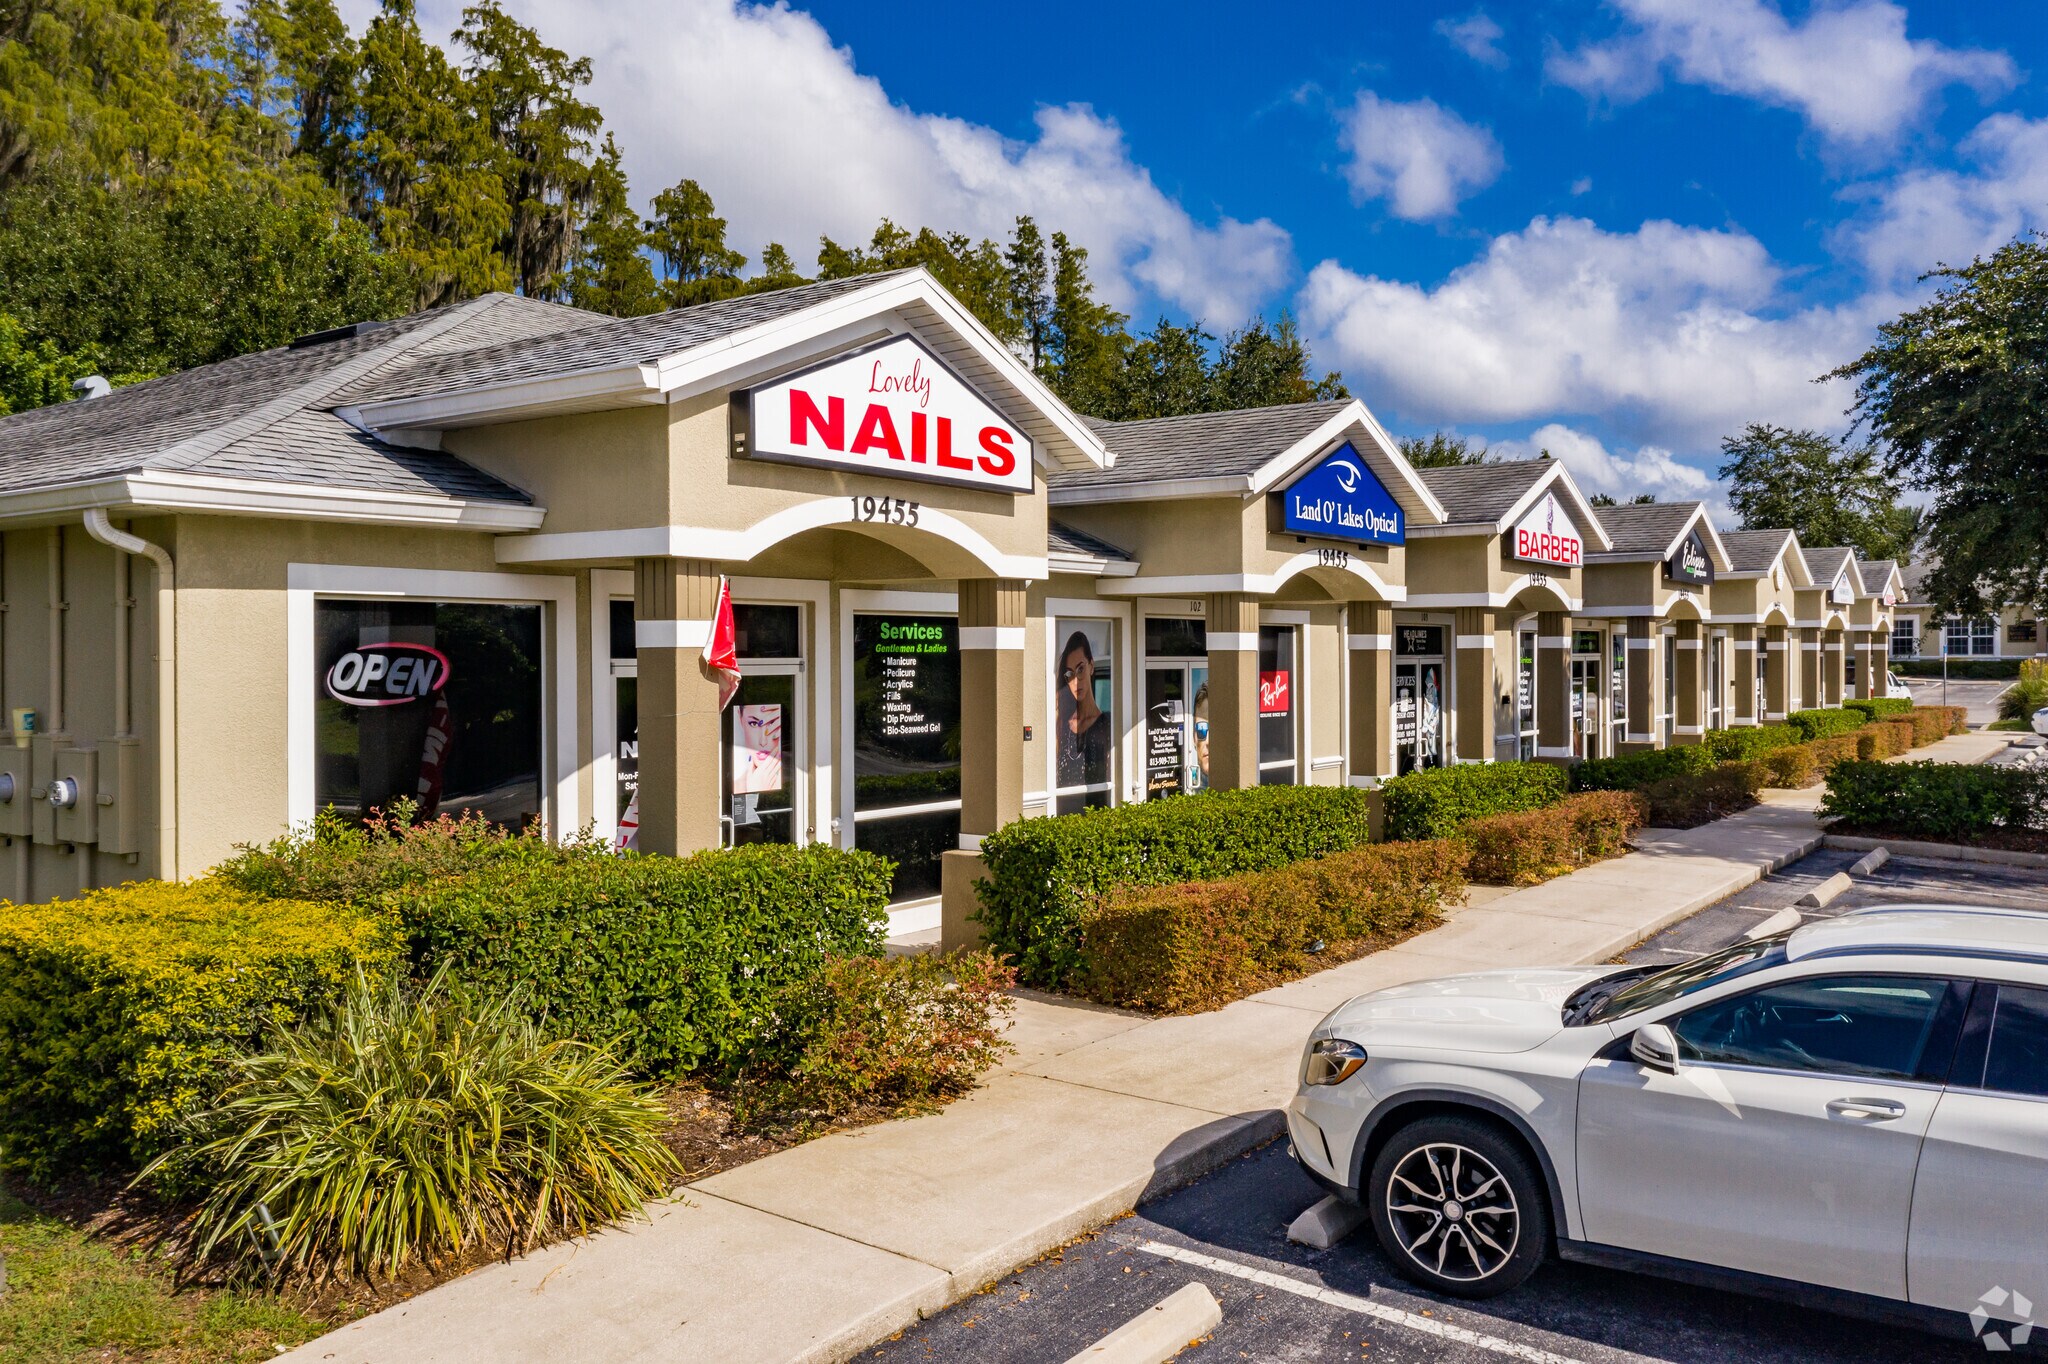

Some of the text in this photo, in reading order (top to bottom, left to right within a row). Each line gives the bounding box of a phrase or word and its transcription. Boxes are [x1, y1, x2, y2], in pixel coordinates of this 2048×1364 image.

[868, 358, 931, 408] Lovely
[789, 388, 1016, 476] NAILS
[850, 495, 920, 528] 19455
[1295, 495, 1398, 538] Land O' Lakes Optical
[1518, 529, 1580, 564] BARBER
[1317, 549, 1349, 569] 19455
[1529, 573, 1547, 587] 19455
[1190, 601, 1201, 611] 102
[881, 622, 943, 640] Services
[875, 643, 948, 653] Gentlemen & Ladies
[886, 656, 917, 666] Manicure
[332, 652, 438, 696] OPEN
[886, 668, 916, 678] Pedicure
[886, 680, 914, 690] Acrylics
[1260, 675, 1287, 707] Ray-Ban
[886, 703, 912, 713] Waxing
[887, 713, 925, 724] Dip Powder
[887, 723, 941, 735] Bio-Seaweed Gel
